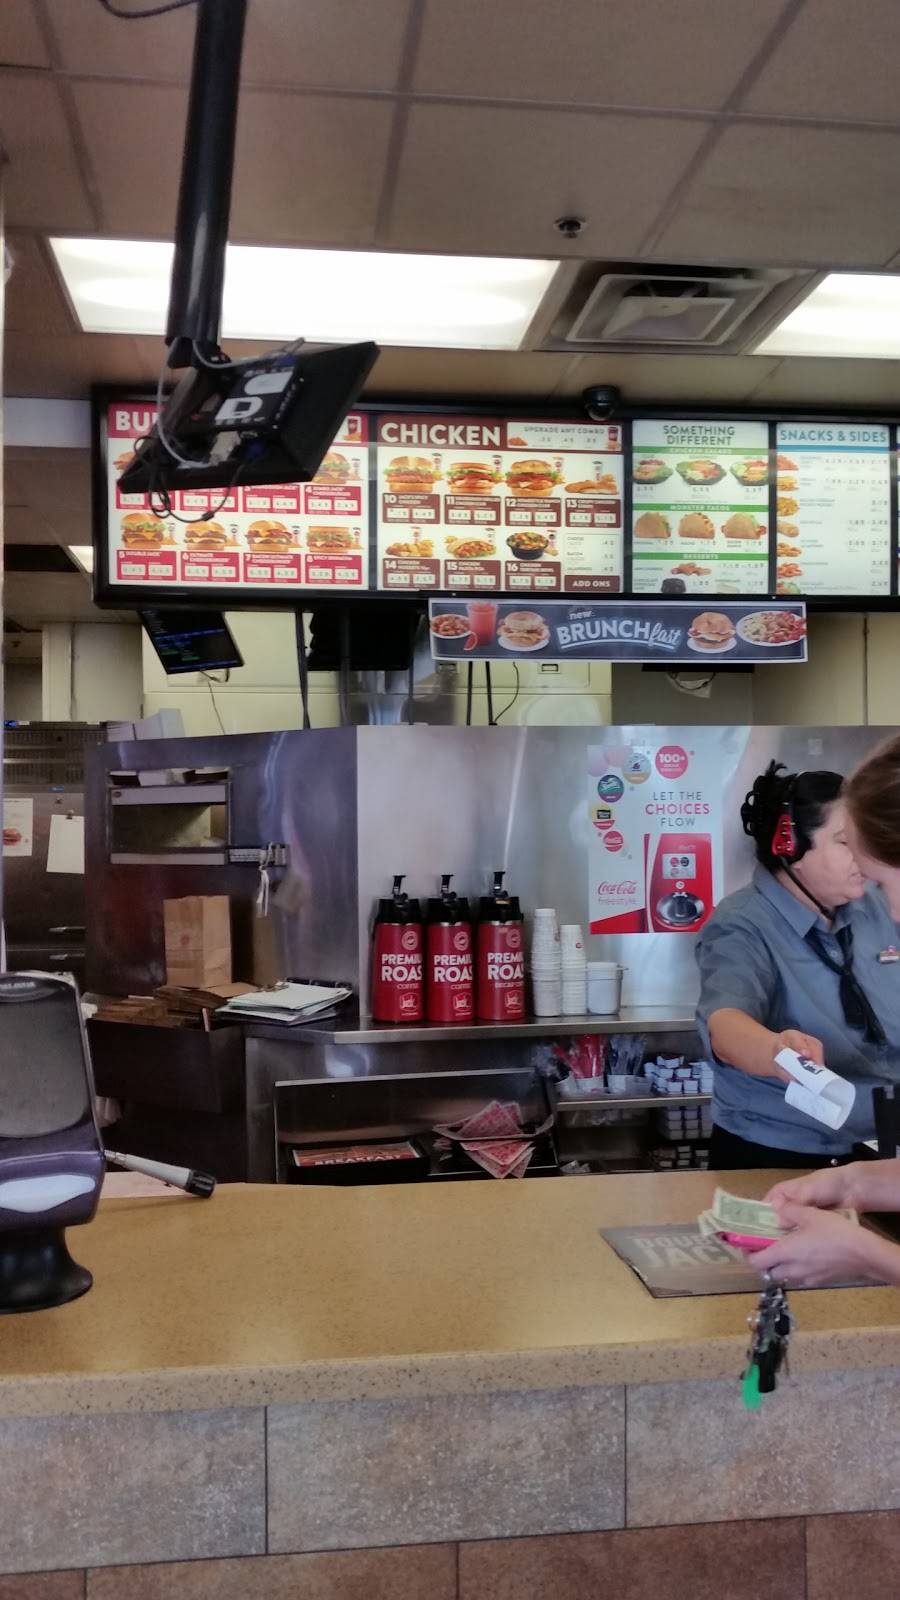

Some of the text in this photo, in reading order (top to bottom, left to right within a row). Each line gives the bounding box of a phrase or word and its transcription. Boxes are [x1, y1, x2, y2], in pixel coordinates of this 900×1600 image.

[381, 422, 500, 446] CHICKEN
[663, 425, 735, 436] SOMETHING
[667, 435, 732, 446] DIFFERENT
[780, 430, 887, 442] SNACKS & SIDES
[383, 494, 397, 503] 10
[446, 496, 455, 504] 11
[506, 498, 516, 507] 12
[567, 499, 577, 508] 13
[182, 552, 189, 560] 6
[245, 553, 251, 561] 7
[384, 560, 397, 569] 14
[446, 561, 457, 570] 15
[507, 563, 518, 572] 16
[569, 610, 593, 620] new
[658, 753, 685, 763] 100+
[653, 791, 702, 801] LET THE
[645, 803, 710, 815] CHOICES
[660, 817, 696, 827] FLOW
